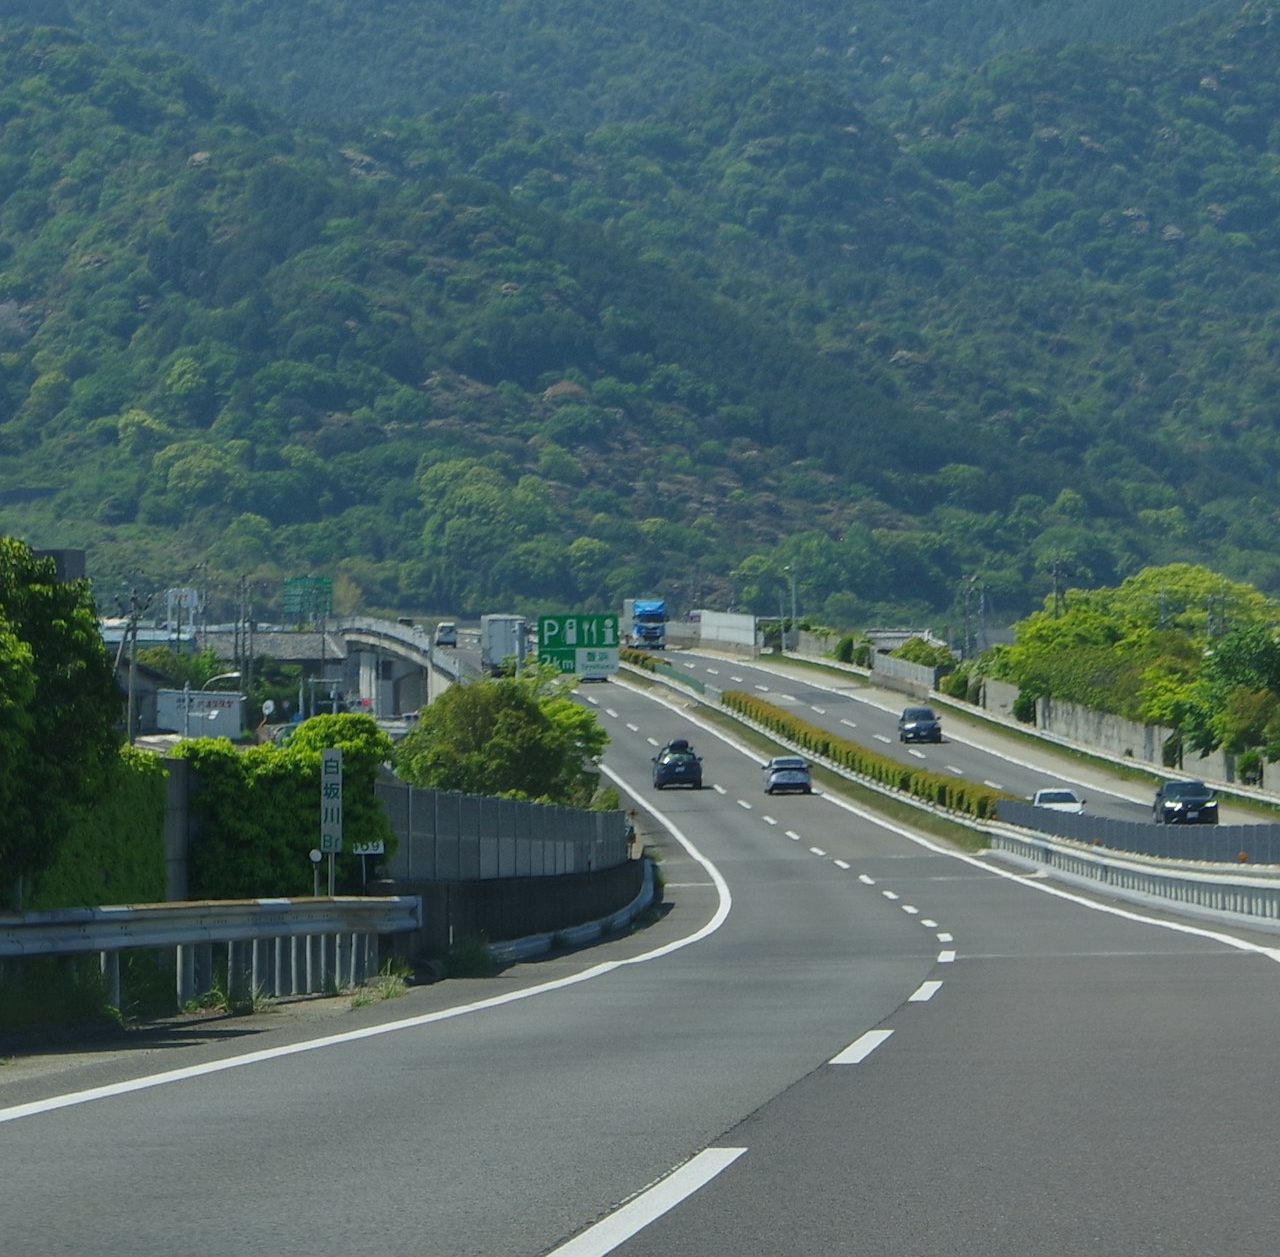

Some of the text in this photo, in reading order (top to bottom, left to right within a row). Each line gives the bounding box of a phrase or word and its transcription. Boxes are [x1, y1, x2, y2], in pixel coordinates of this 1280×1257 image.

[543, 619, 559, 646] P
[323, 758, 340, 848] 白坂川 Br
